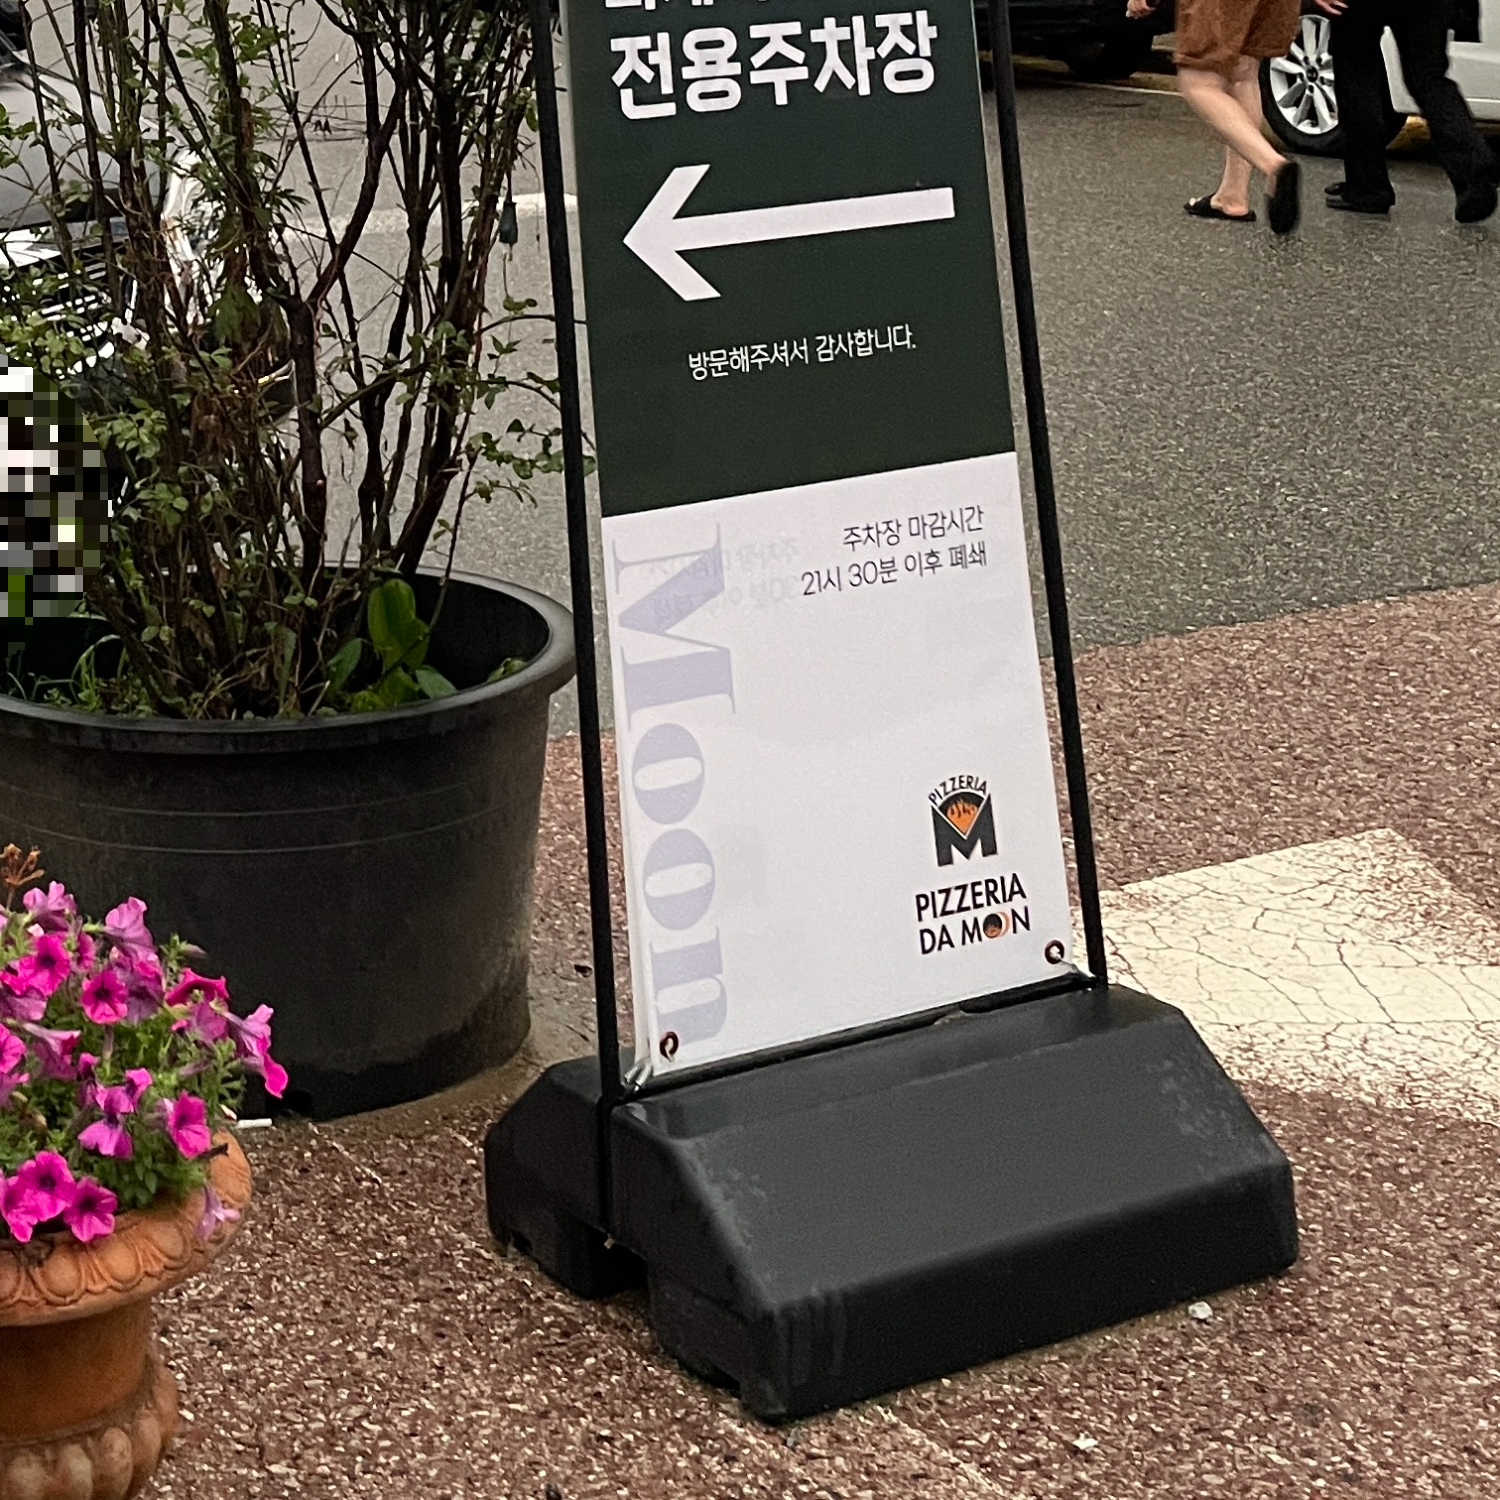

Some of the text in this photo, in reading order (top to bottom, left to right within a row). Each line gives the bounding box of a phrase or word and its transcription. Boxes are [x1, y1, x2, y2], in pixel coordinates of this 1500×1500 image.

[610, 10, 938, 120] 전용주차장
[688, 323, 917, 381] 방문해주셔서 감사합니다.
[843, 505, 984, 552] 주차장 마감시간
[801, 541, 988, 596] 21시 30분 이후 폐쇄
[928, 775, 988, 807] PIZZERIA
[915, 872, 1027, 922] PIZZERIA
[919, 923, 955, 955] DA
